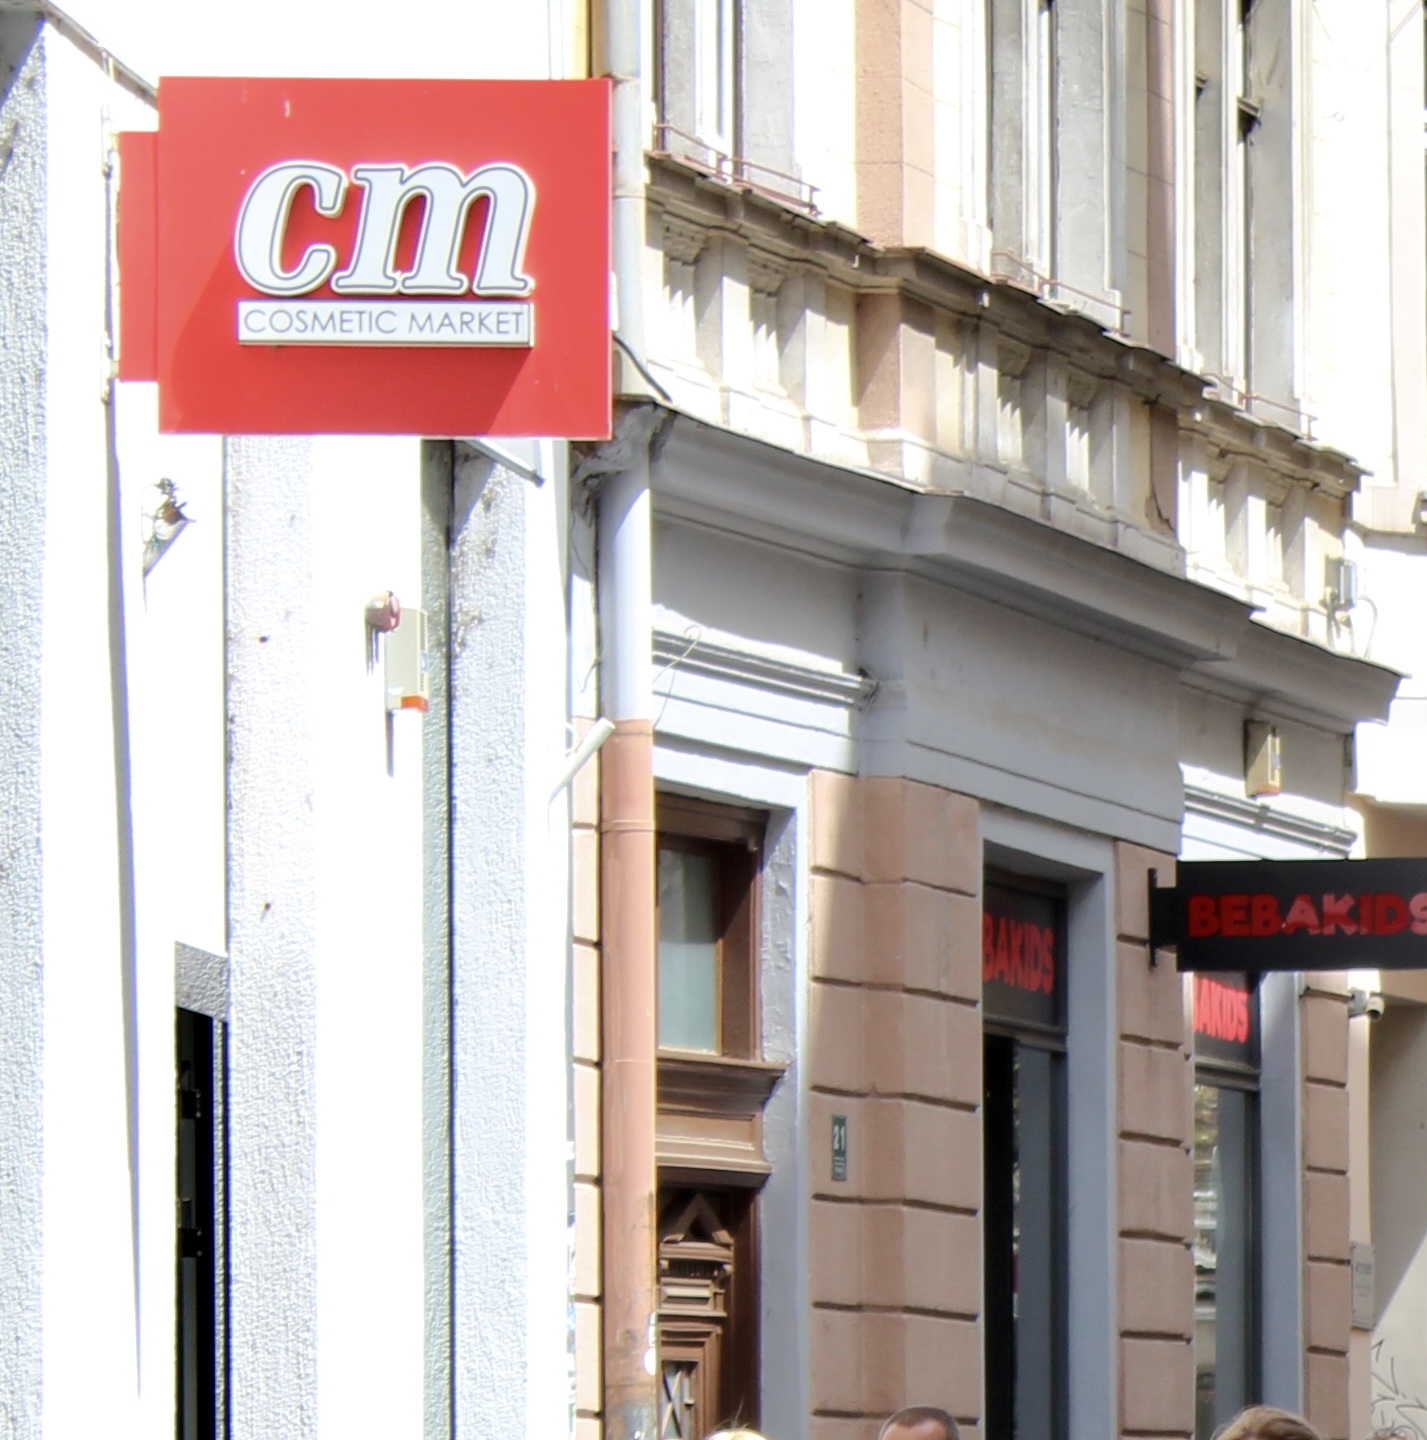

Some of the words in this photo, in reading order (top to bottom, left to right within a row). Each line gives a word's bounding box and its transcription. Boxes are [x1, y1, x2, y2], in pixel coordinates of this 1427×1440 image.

[235, 160, 536, 296] cm
[244, 309, 397, 334] COSMETIC
[408, 311, 524, 335] MARKET
[983, 911, 1055, 995] BAKIDS
[1194, 977, 1249, 1044] AKIDS
